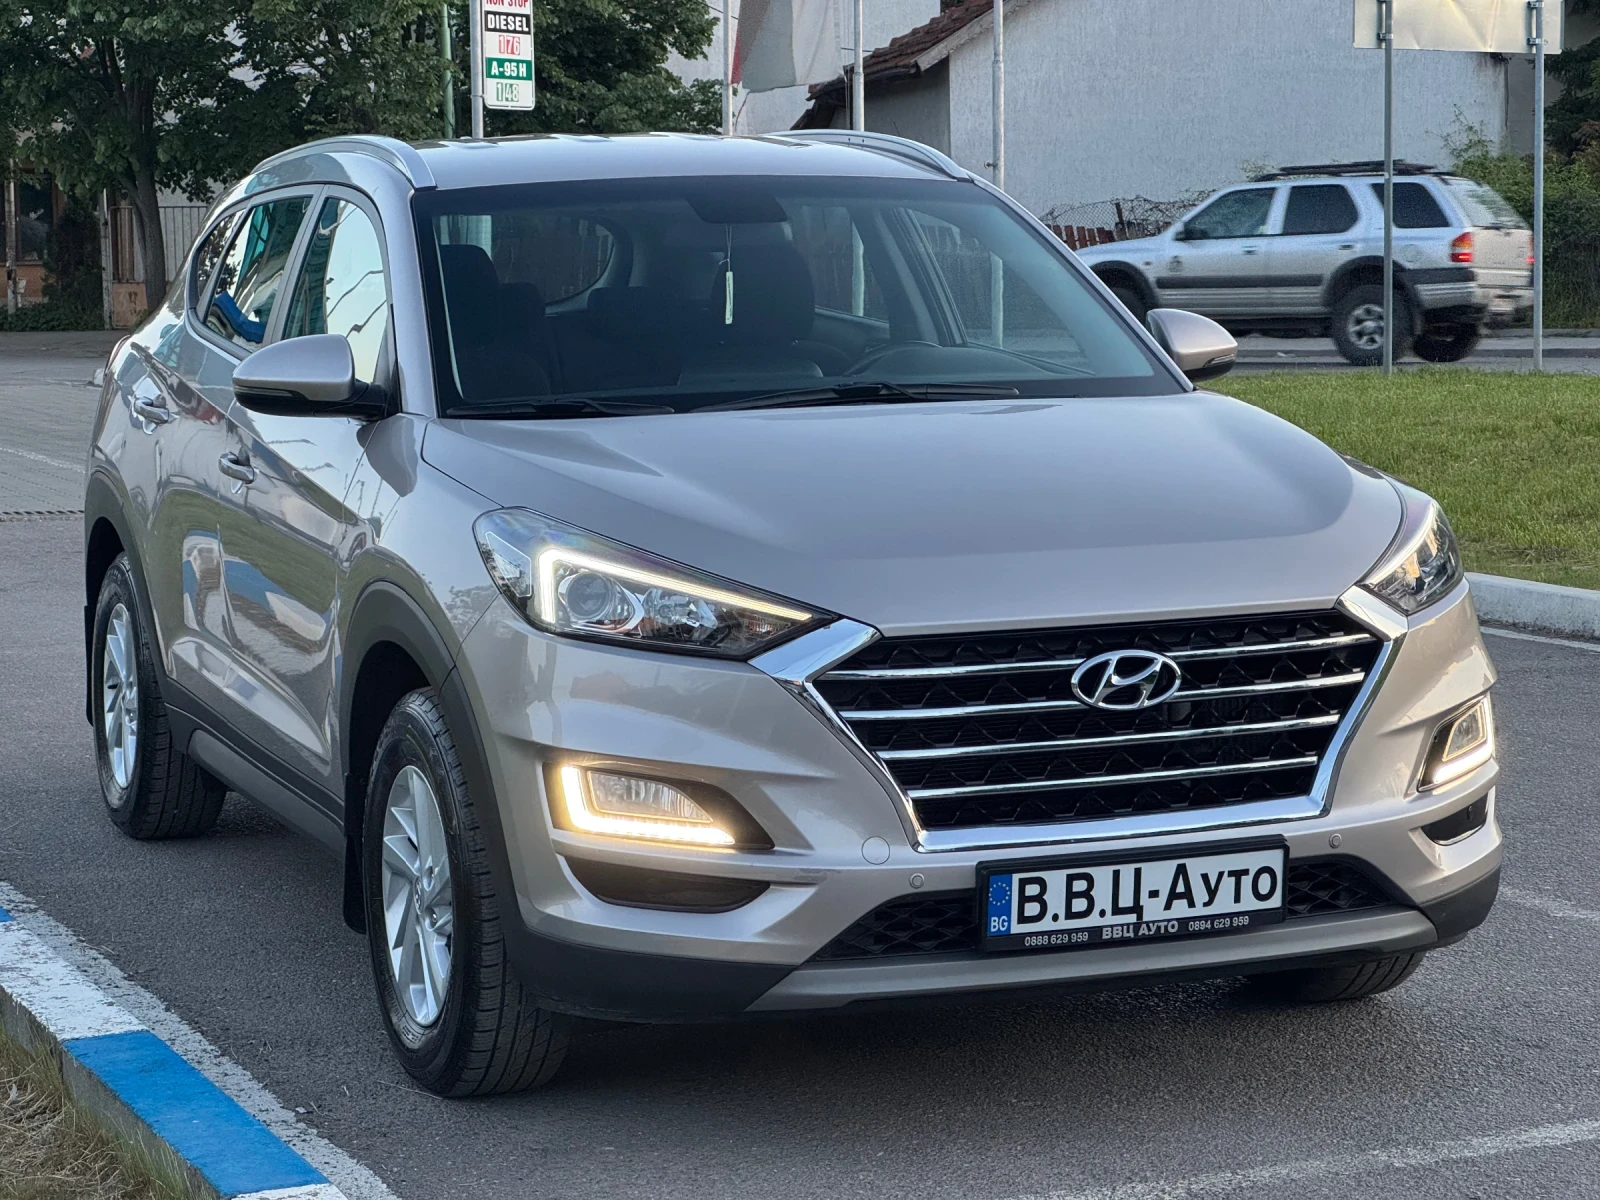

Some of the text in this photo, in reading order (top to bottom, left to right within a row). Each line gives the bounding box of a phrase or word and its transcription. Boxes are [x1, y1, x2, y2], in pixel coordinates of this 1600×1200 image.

[487, 14, 529, 31] DIESEL
[990, 915, 1008, 932] BG
[1102, 921, 1178, 939] ВВЦ АУТО
[1188, 915, 1250, 932] 0894 629 959
[1024, 931, 1089, 947] 0888 629 959
